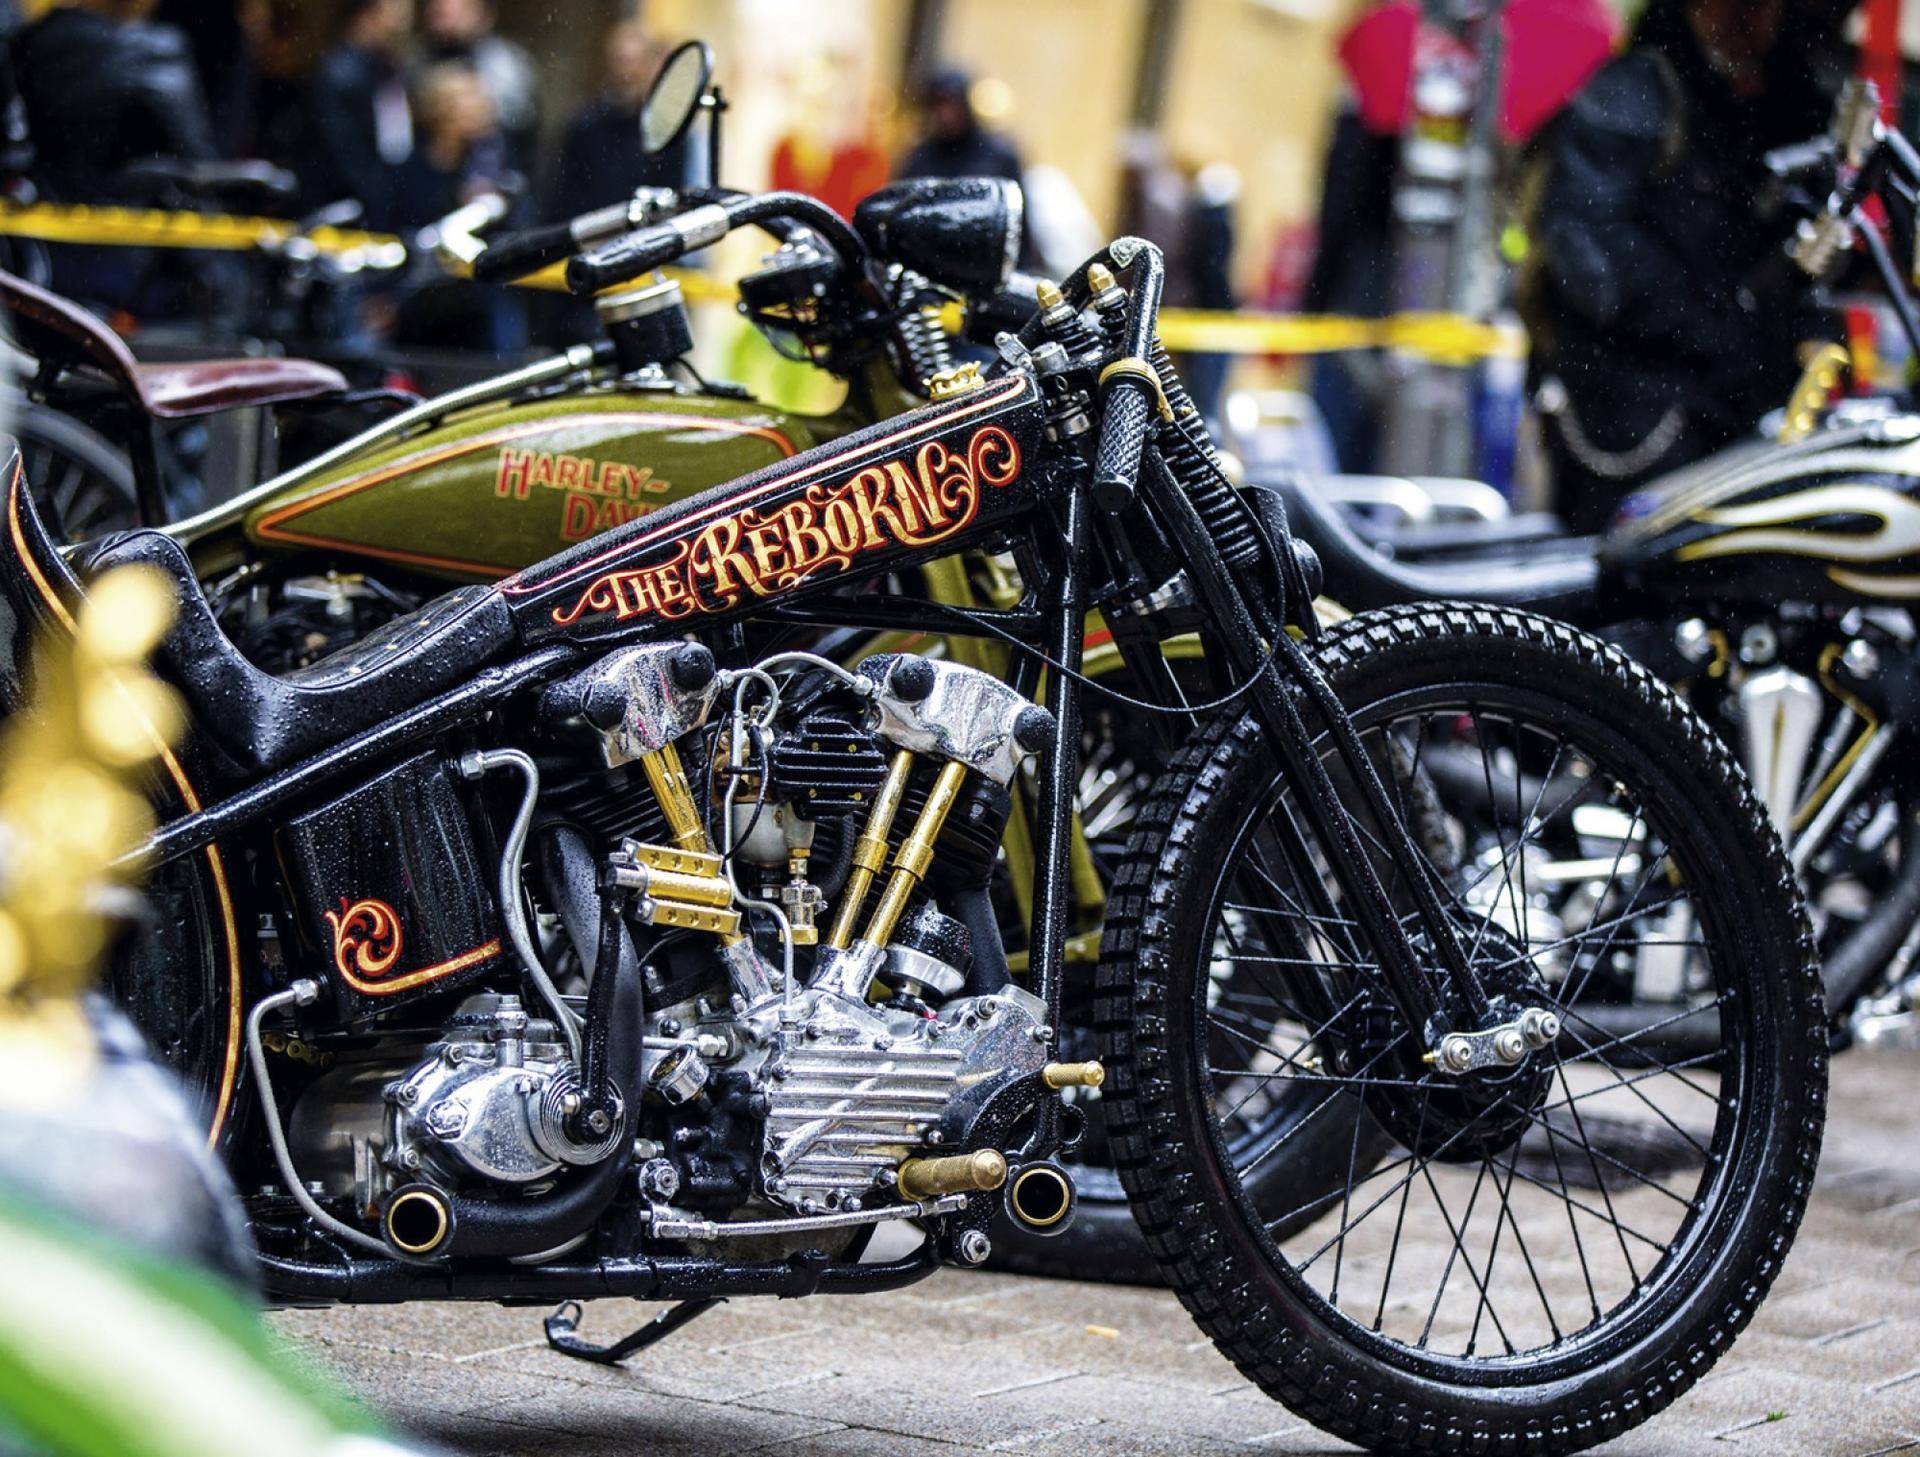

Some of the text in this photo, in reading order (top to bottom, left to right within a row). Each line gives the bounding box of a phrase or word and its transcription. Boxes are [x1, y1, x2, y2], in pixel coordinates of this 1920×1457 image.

[496, 448, 671, 501] HARLEY-
[552, 424, 1022, 625] THE REBORN
